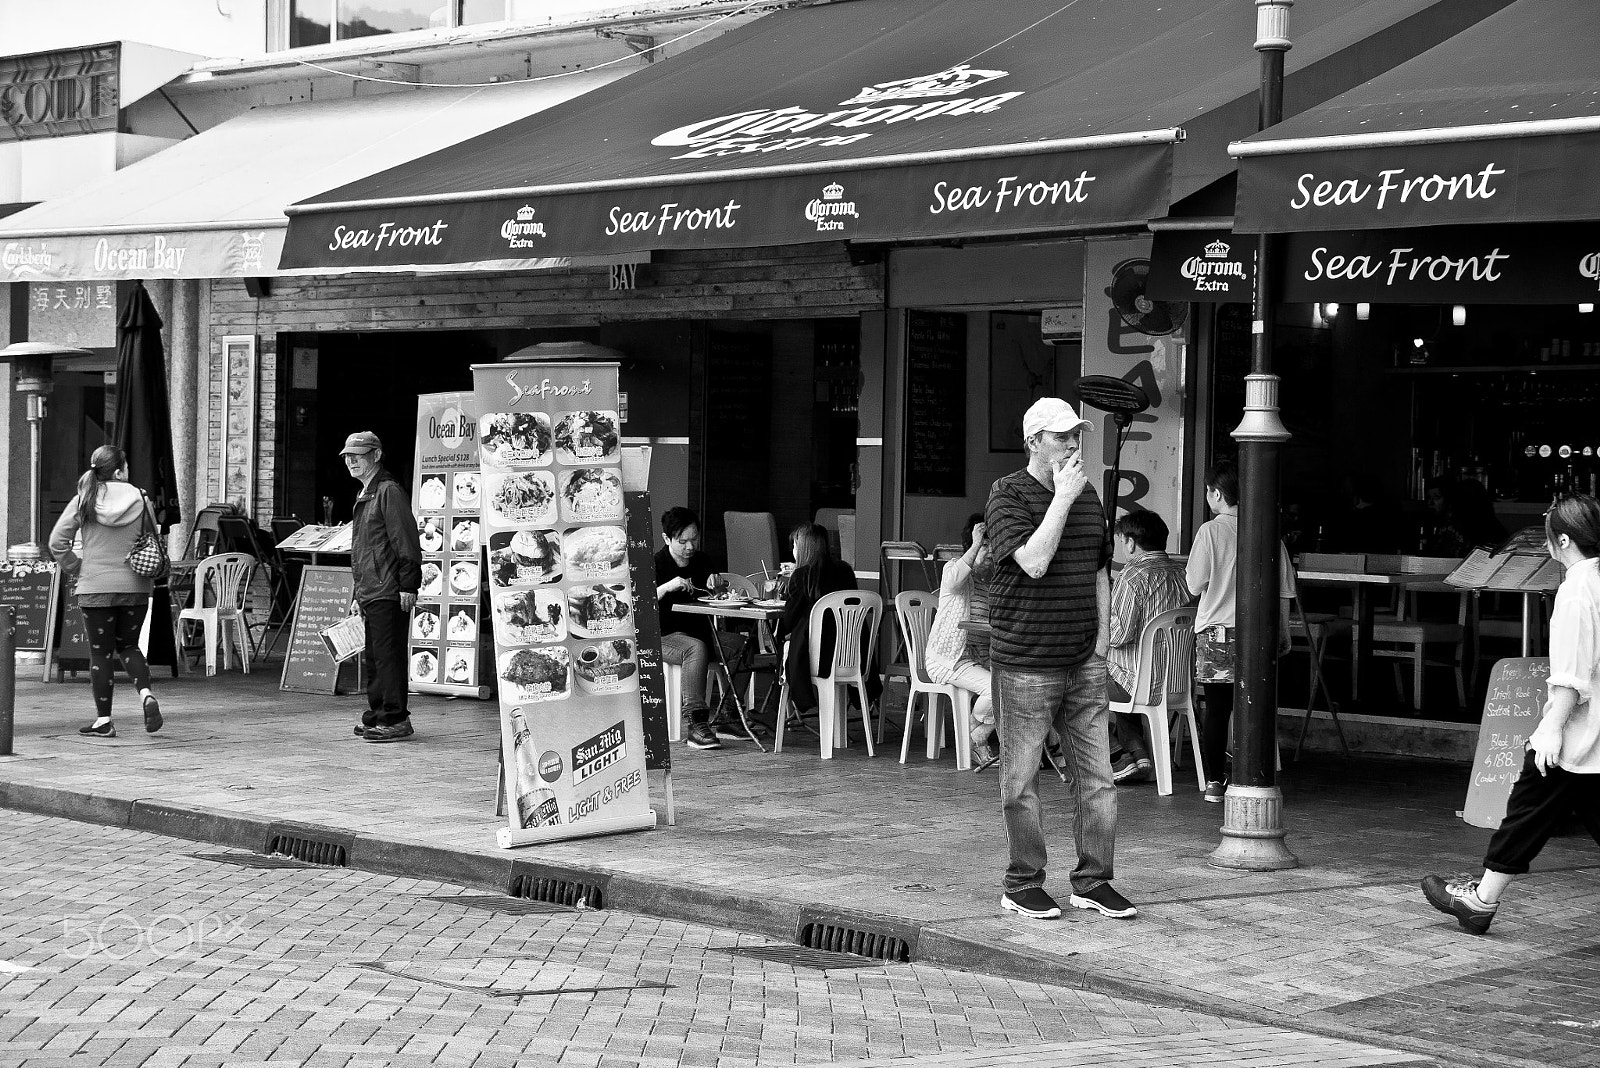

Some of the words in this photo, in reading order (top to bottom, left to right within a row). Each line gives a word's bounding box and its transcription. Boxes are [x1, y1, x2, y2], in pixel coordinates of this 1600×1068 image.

[651, 92, 1026, 146] Corona
[930, 181, 992, 213] Sea
[995, 171, 1096, 212] Front
[1291, 174, 1371, 209] Sea
[1377, 163, 1506, 209] Front
[606, 206, 657, 236] Sea
[658, 200, 741, 236] Front
[805, 198, 856, 222] Corona
[817, 217, 844, 231] Extra
[329, 225, 376, 250] Sea
[376, 220, 448, 251] Front
[501, 219, 544, 240] Corona
[509, 235, 534, 249] Extra
[2, 242, 52, 271] Carlsberg
[94, 237, 148, 272] Ocean
[154, 235, 187, 275] Bay
[1181, 256, 1242, 281] Corona
[1305, 247, 1383, 281] Sea
[1387, 247, 1510, 286] Front
[609, 262, 637, 291] BAY
[1195, 276, 1229, 291] Extra
[429, 416, 455, 438] Ocean
[459, 415, 476, 441] Bay
[577, 740, 600, 765] San
[599, 728, 622, 754] Mig
[581, 749, 620, 780] LIGHT
[568, 791, 600, 823] LIGHT
[602, 785, 613, 804] &
[614, 769, 641, 796] FREE
